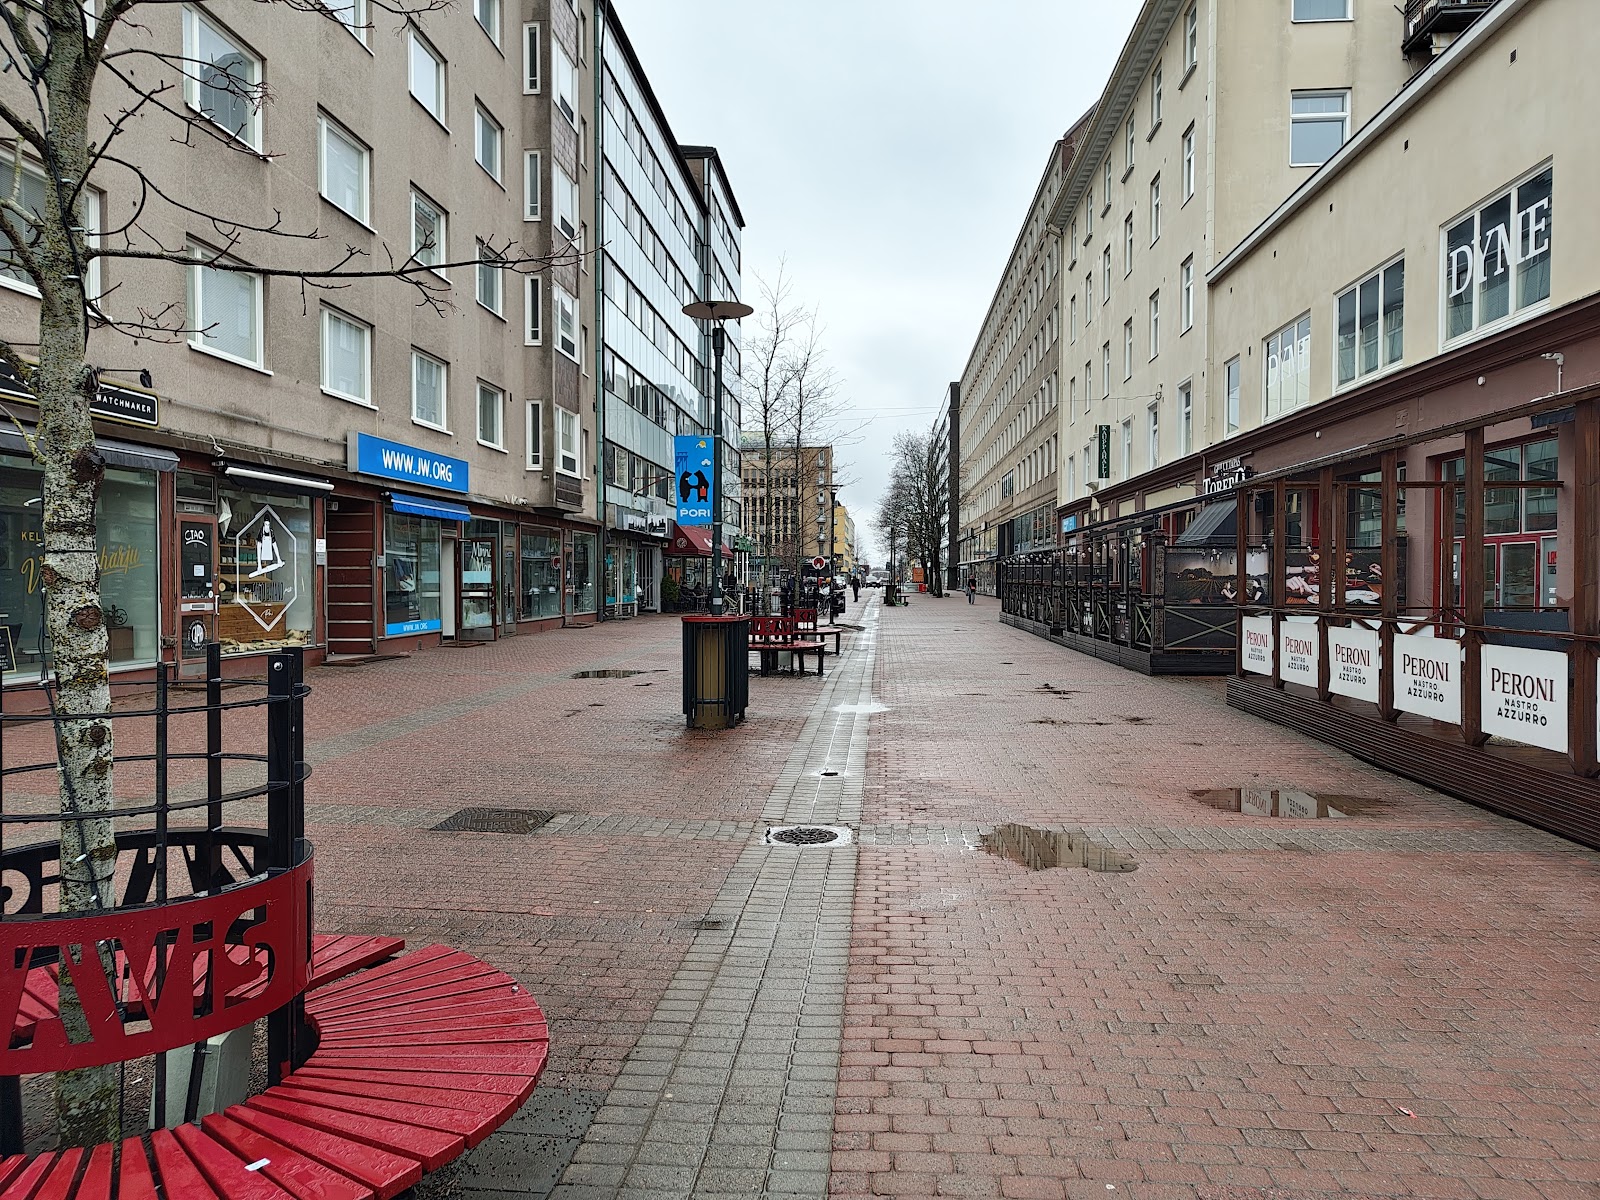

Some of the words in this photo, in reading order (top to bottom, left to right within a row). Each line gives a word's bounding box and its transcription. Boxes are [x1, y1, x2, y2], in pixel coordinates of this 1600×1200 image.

[1449, 197, 1549, 299] DYNE
[95, 394, 151, 413] WATCHMAKER
[382, 448, 452, 482] WWW.JW.ORG
[680, 508, 710, 517] PORI
[21, 531, 42, 541] KEL
[184, 529, 204, 540] CIAO
[1246, 630, 1268, 648] PERONI
[1285, 636, 1312, 656] PERONI
[1335, 643, 1370, 667] PERONI
[1287, 662, 1310, 672] AZZURRO
[1342, 665, 1362, 675] NASTRO
[1403, 653, 1450, 682] PERONI
[1338, 672, 1367, 685] AZZURRO
[1413, 679, 1438, 691] NASTRO
[1491, 667, 1555, 702] PERONI
[1407, 687, 1444, 703] AZZURRO
[1504, 698, 1539, 712] NASTRO
[1497, 707, 1547, 727] AZZURRO
